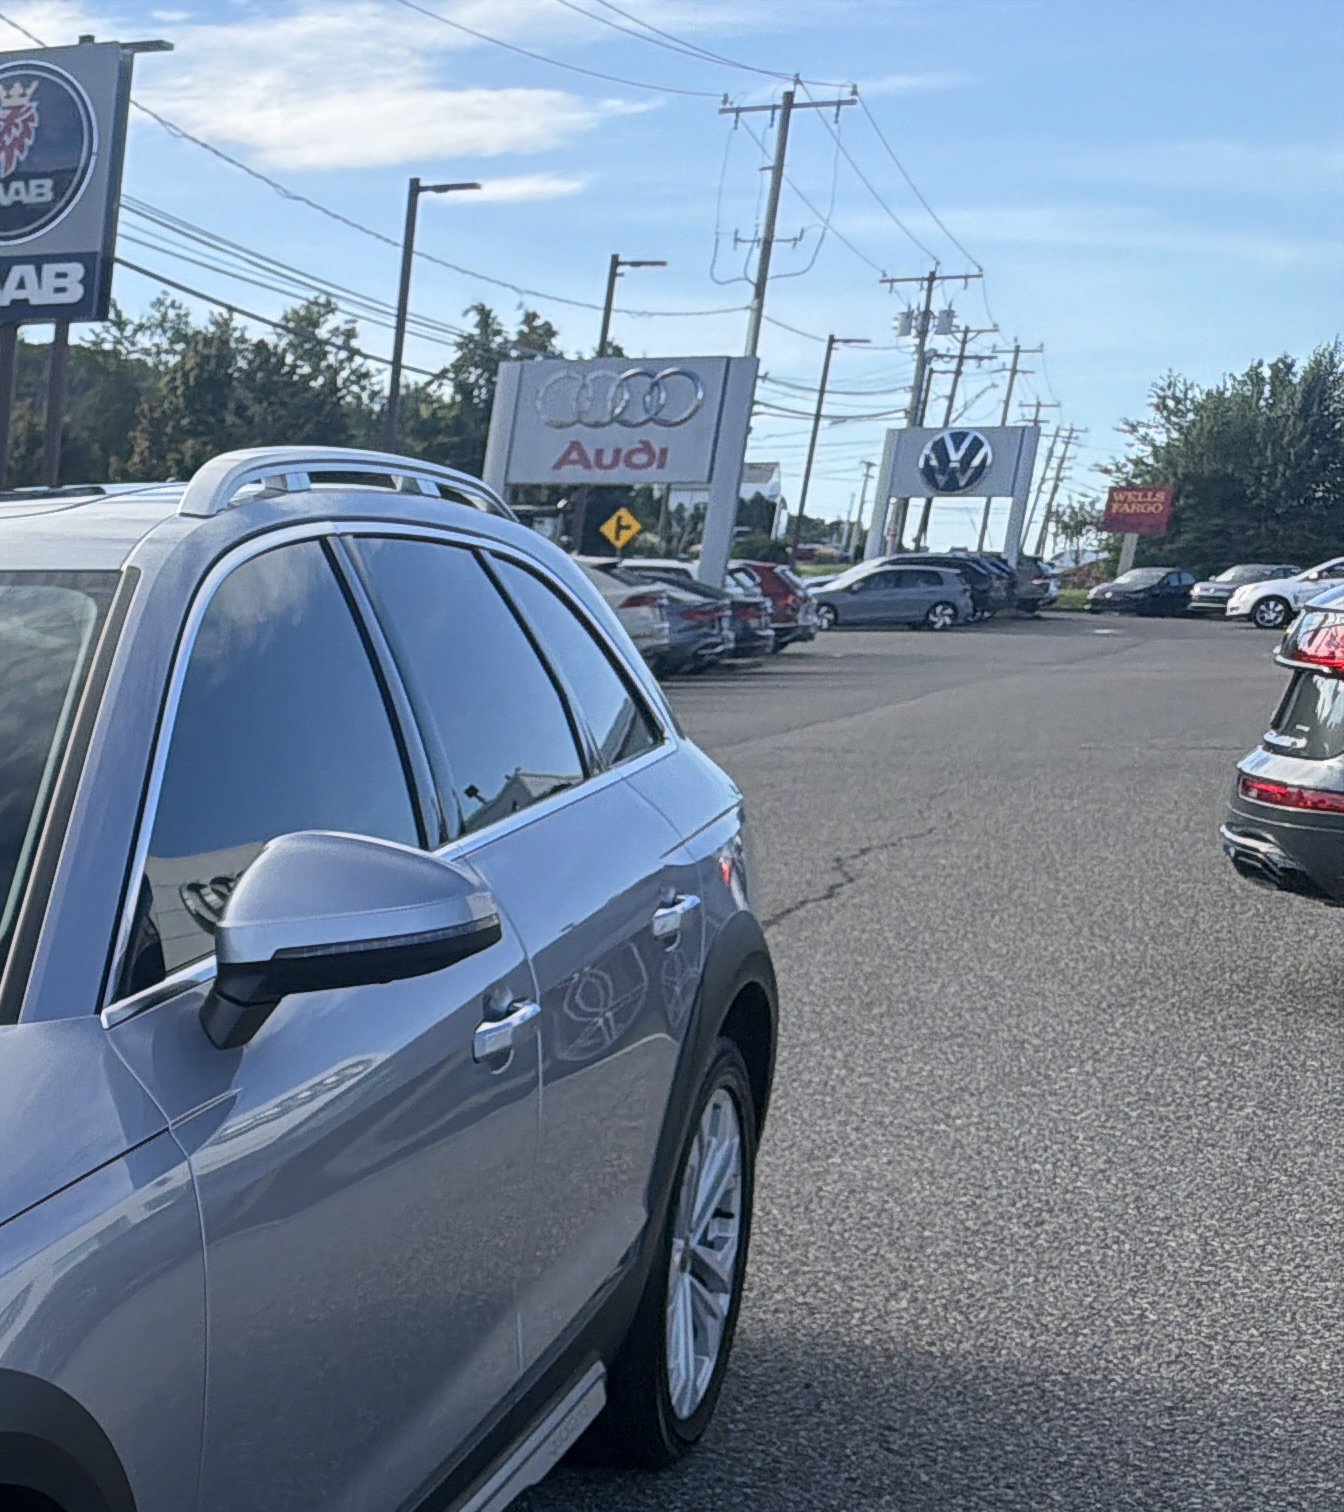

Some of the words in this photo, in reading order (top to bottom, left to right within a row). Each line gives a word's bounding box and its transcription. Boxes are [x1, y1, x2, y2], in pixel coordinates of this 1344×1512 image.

[551, 438, 669, 471] Audi
[1112, 490, 1167, 502] WELLS
[1111, 502, 1164, 514] FARGO
